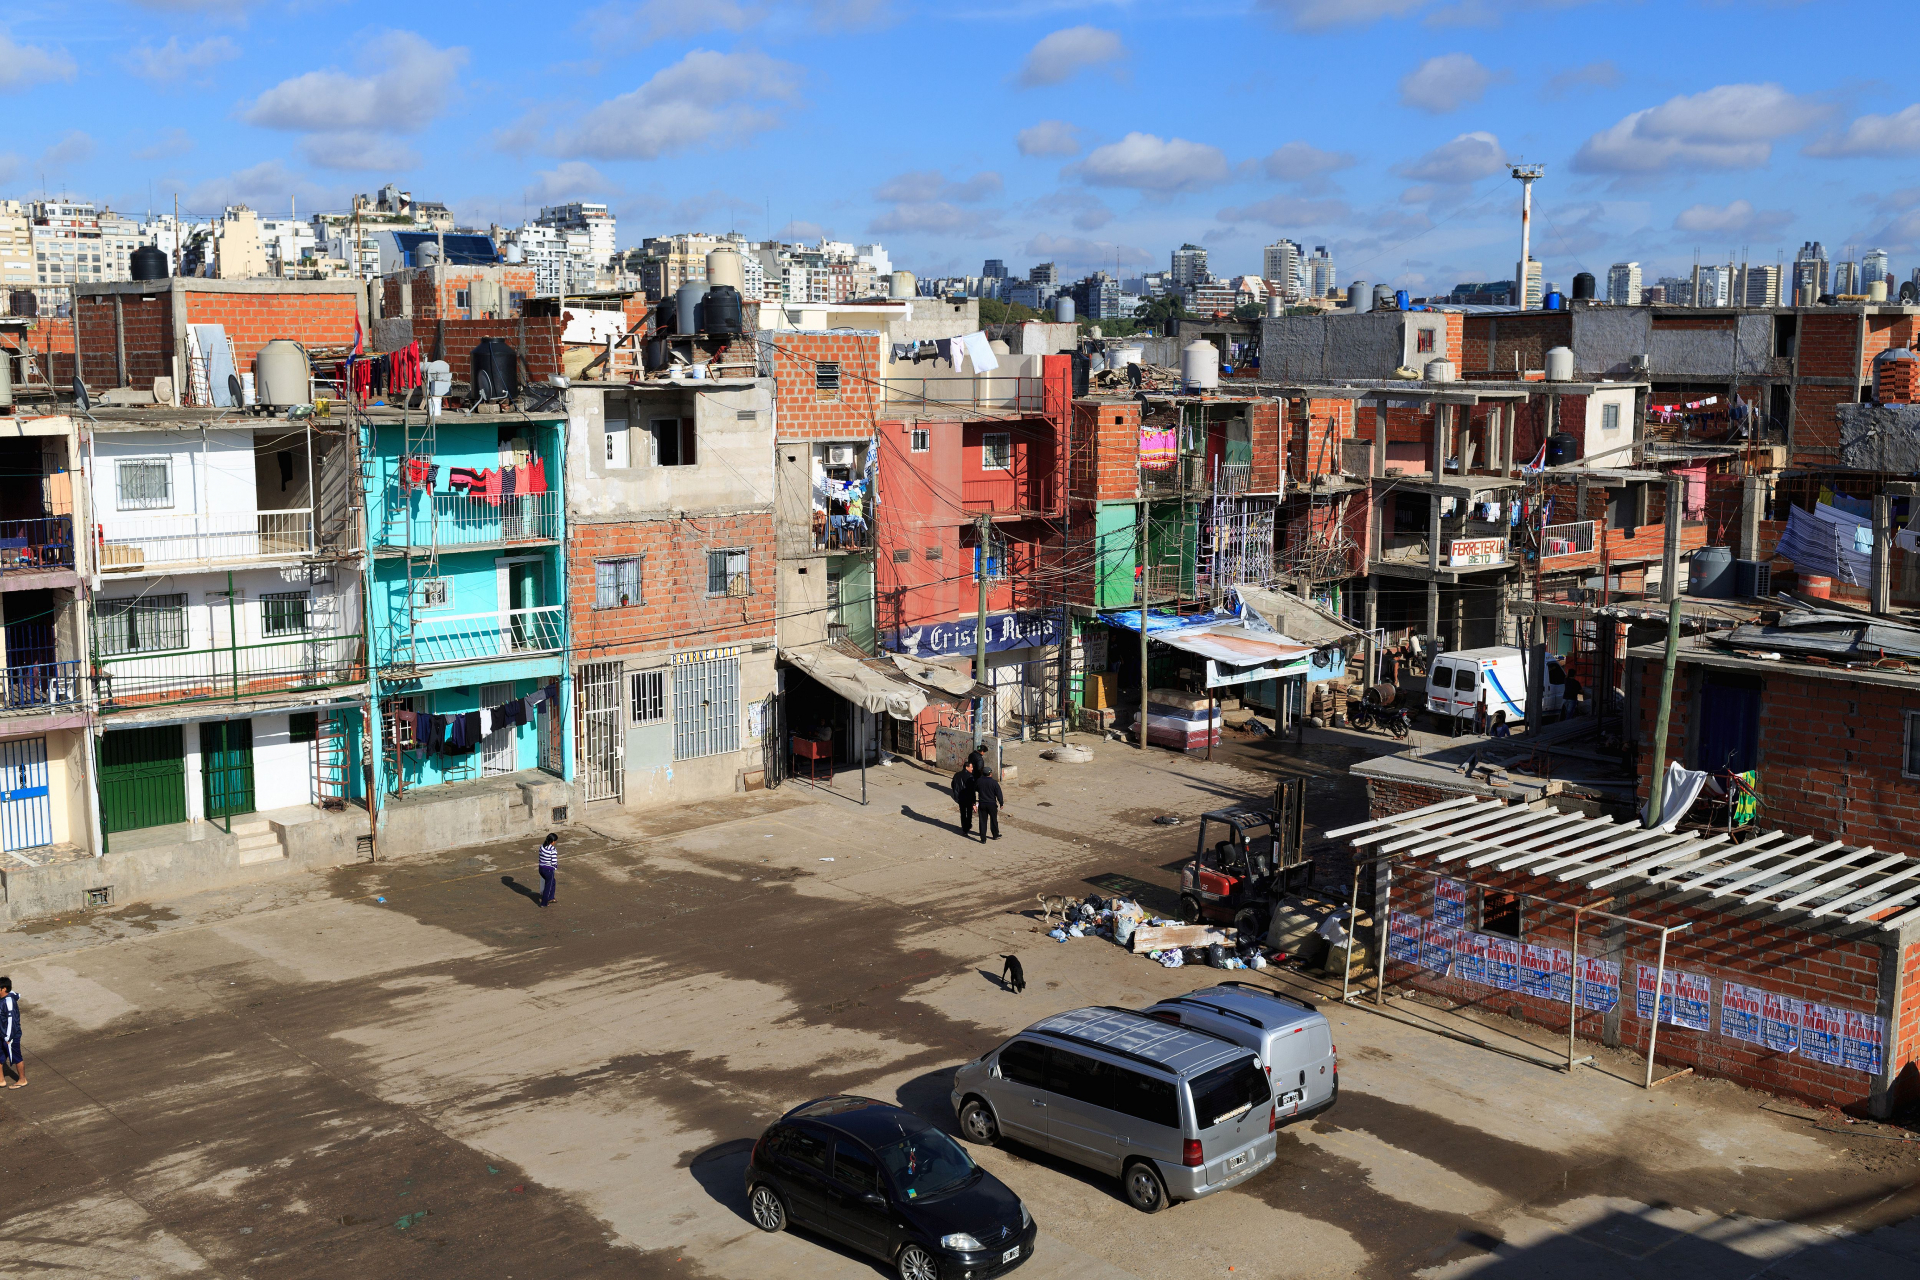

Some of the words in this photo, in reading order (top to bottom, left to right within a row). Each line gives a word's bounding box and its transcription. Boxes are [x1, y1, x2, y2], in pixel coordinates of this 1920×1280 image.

[1452, 540, 1504, 556] FERRETERIA
[1468, 554, 1490, 564] BETO
[931, 626, 992, 650] Cristo
[1437, 886, 1464, 902] MAYO
[1392, 922, 1418, 938] MAYO
[1425, 932, 1452, 949] MAYO
[1457, 941, 1484, 956] MAYO
[1488, 949, 1516, 964] MAYO
[1521, 956, 1550, 971] MAYO
[1586, 970, 1617, 985] MAYO
[1676, 985, 1708, 1001] MAYO
[1676, 999, 1690, 1008] ACTO
[1724, 995, 1759, 1012] MAYO
[1724, 1009, 1739, 1018] ACTO
[1763, 1005, 1798, 1024] MAYO
[1763, 1020, 1778, 1031] ACTO
[1803, 1015, 1840, 1034] MAYO
[1804, 1031, 1819, 1041] ACTO
[1844, 1024, 1882, 1042] MAYO
[1844, 1040, 1860, 1048] ACTO
